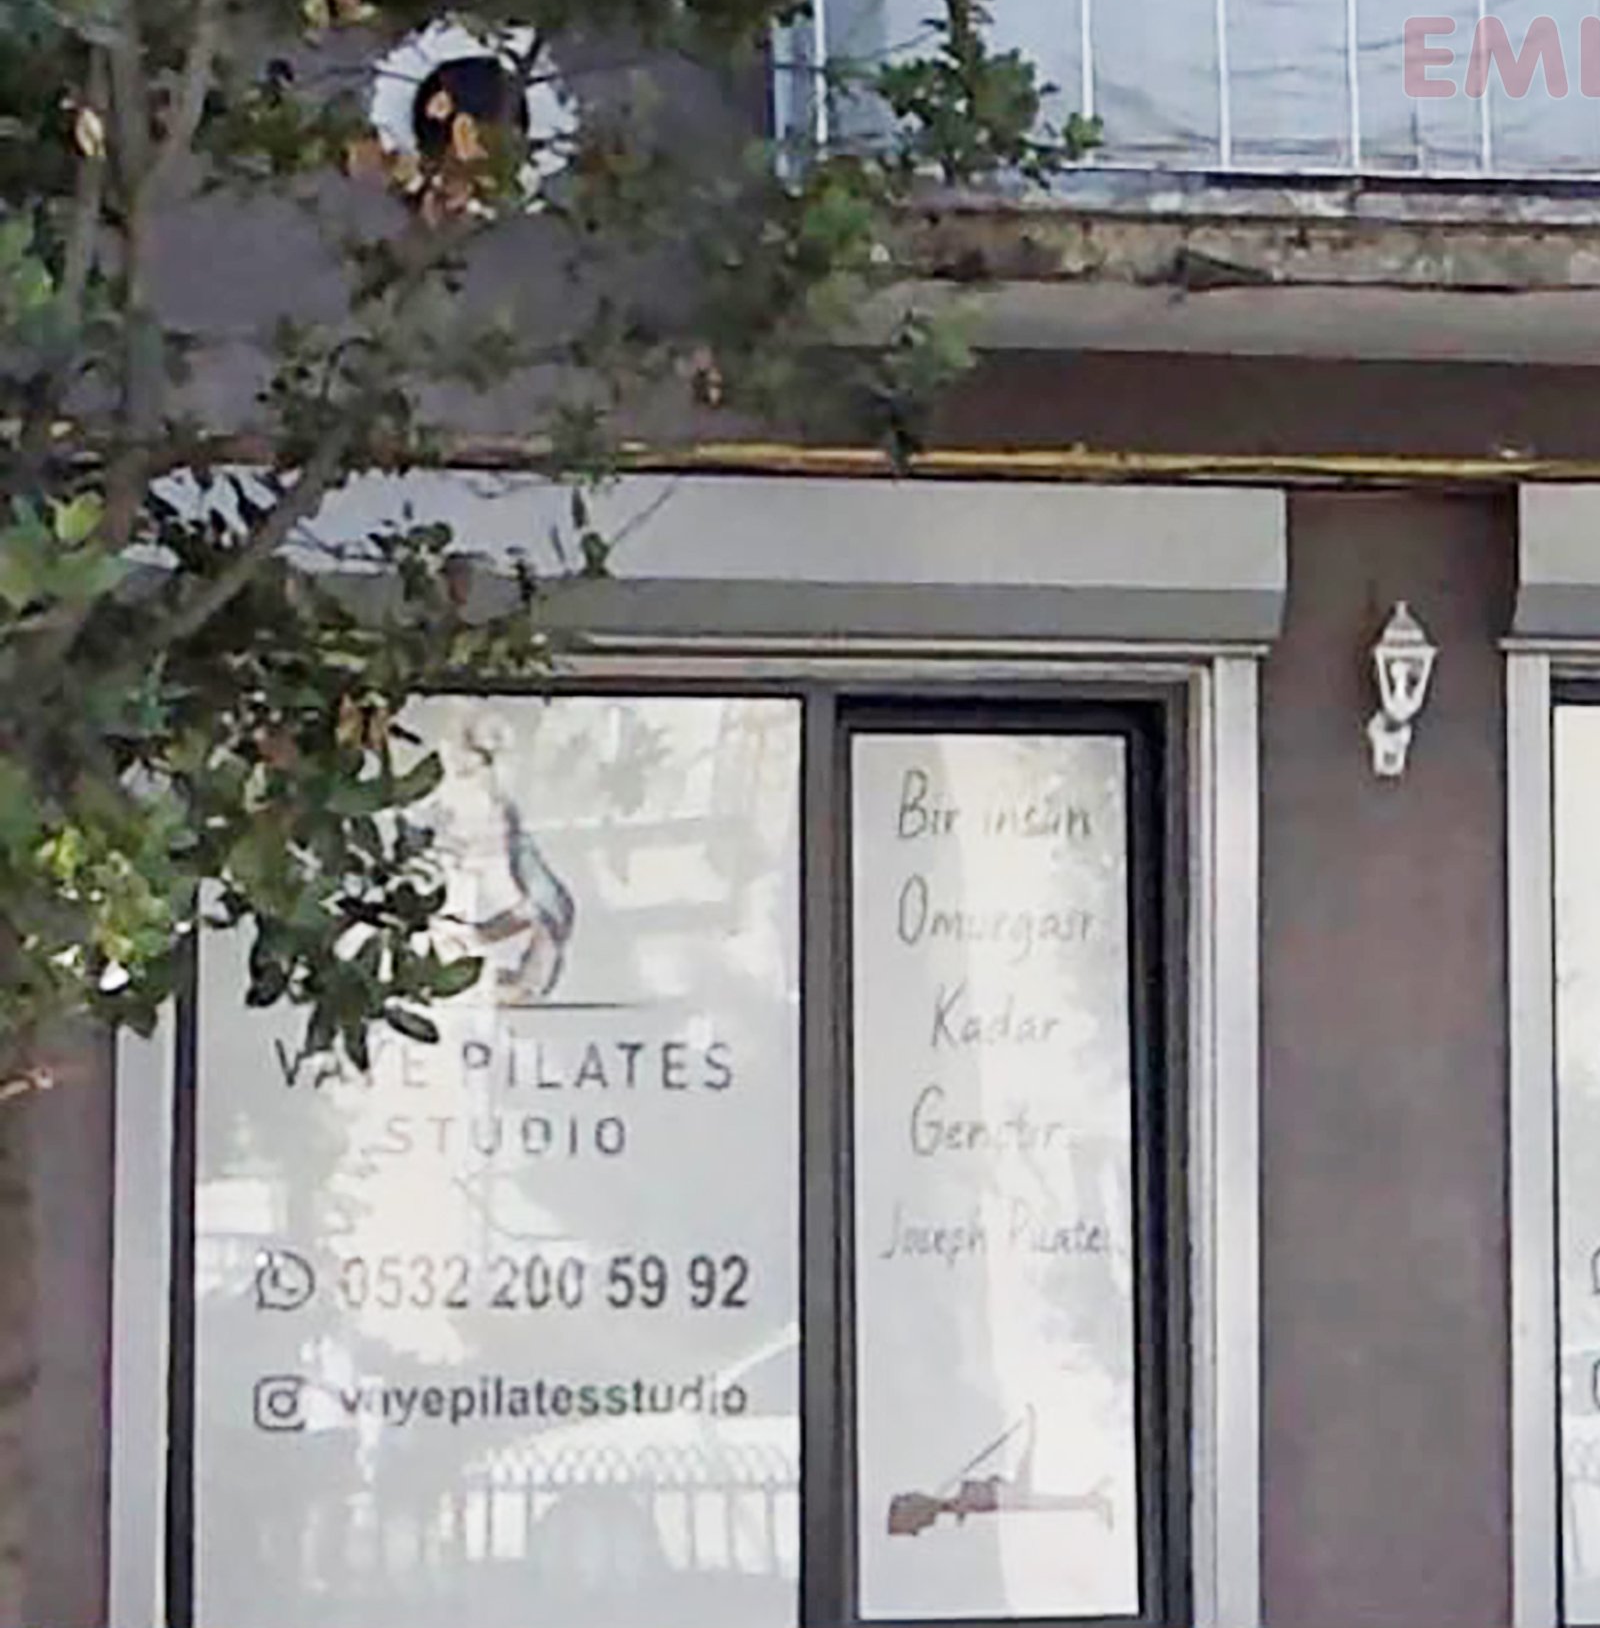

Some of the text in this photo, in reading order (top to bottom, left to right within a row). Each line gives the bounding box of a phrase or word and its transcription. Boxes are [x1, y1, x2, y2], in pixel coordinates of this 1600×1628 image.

[930, 978, 1059, 1048] Kadar
[340, 1253, 751, 1310] 0532 200 59 92
